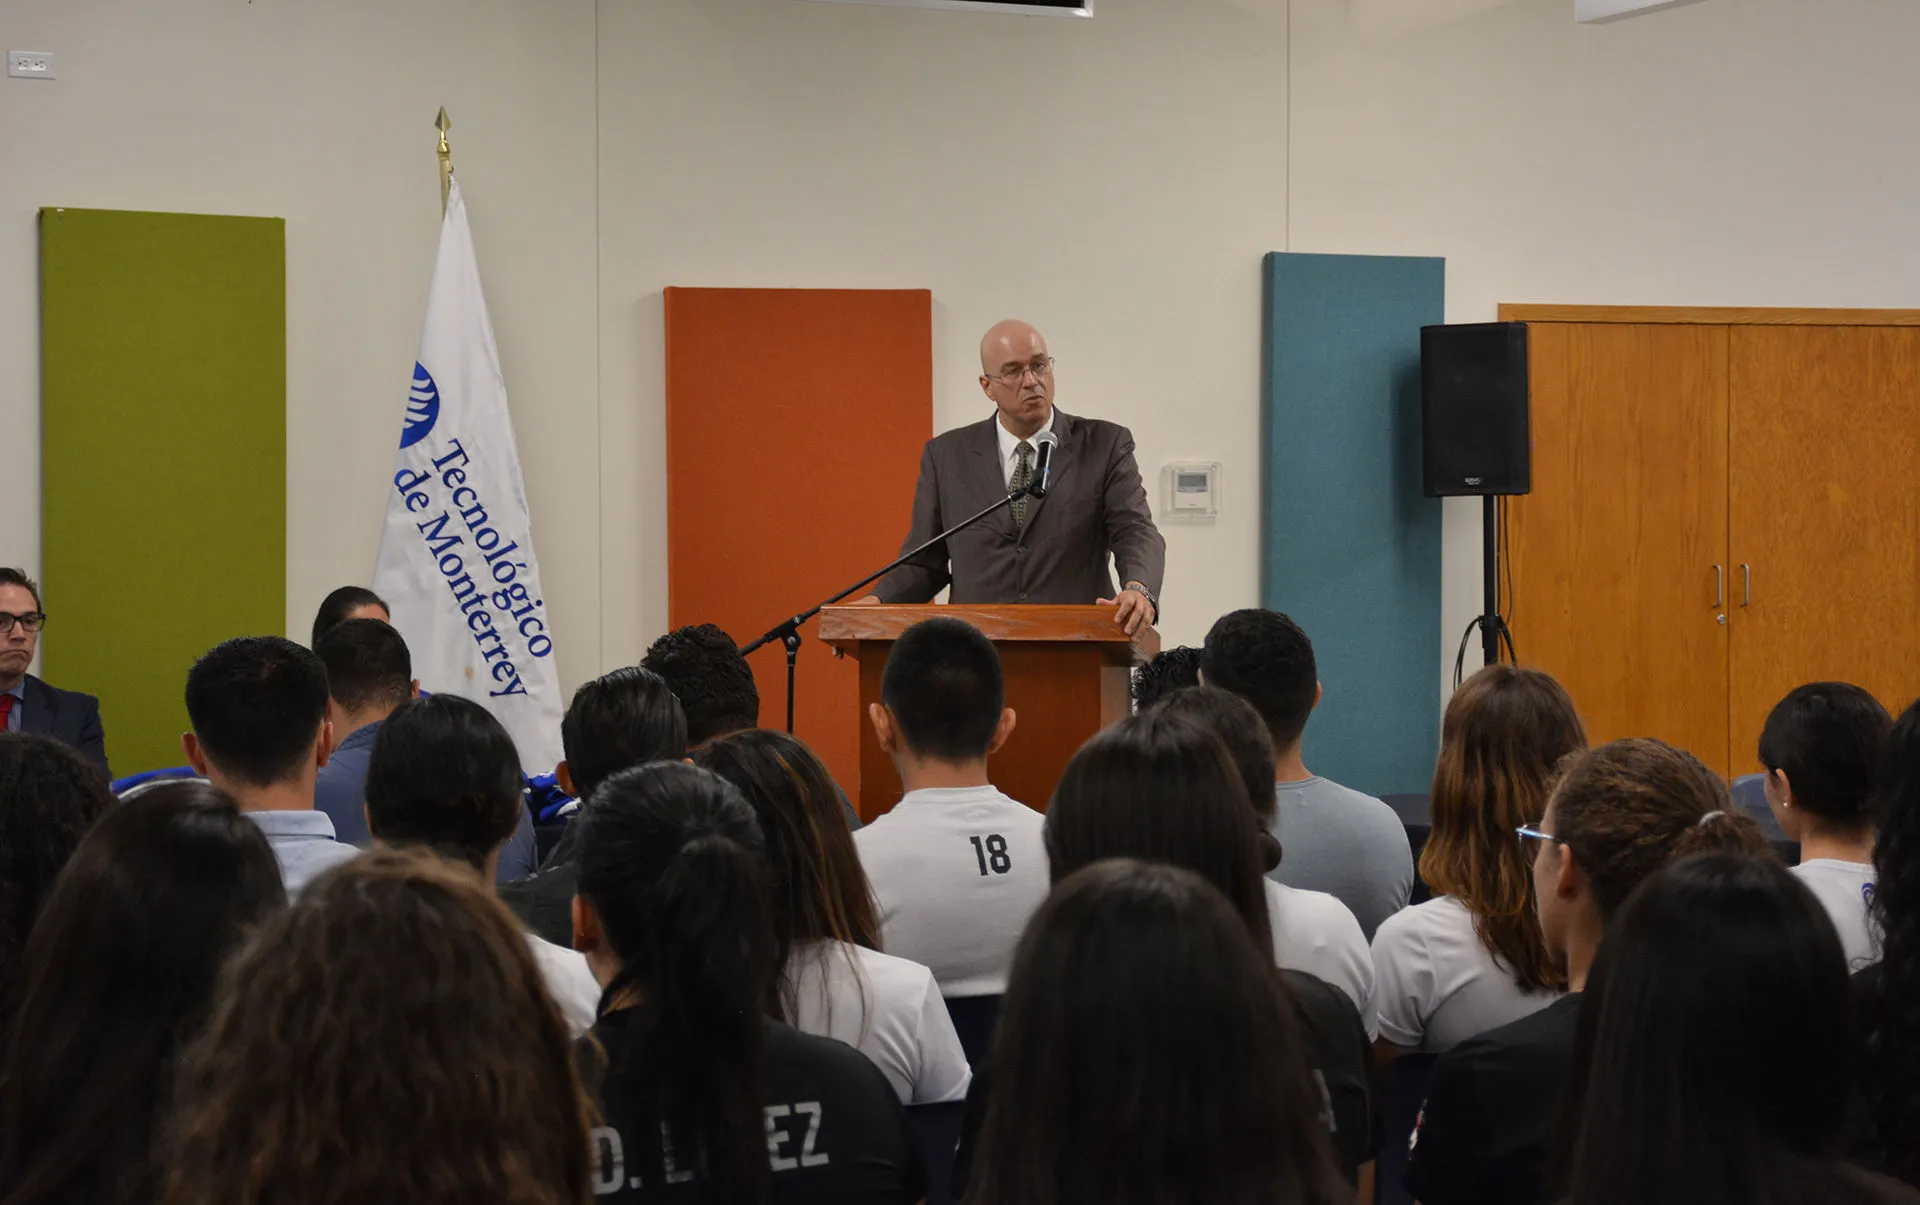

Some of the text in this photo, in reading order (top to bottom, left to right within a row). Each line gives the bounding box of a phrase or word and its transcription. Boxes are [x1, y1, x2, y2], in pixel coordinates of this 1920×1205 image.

[394, 468, 528, 698] de Monterrey
[431, 437, 552, 658] Tecnológico
[969, 834, 1011, 876] 18
[590, 1101, 830, 1195] D. LEZ
